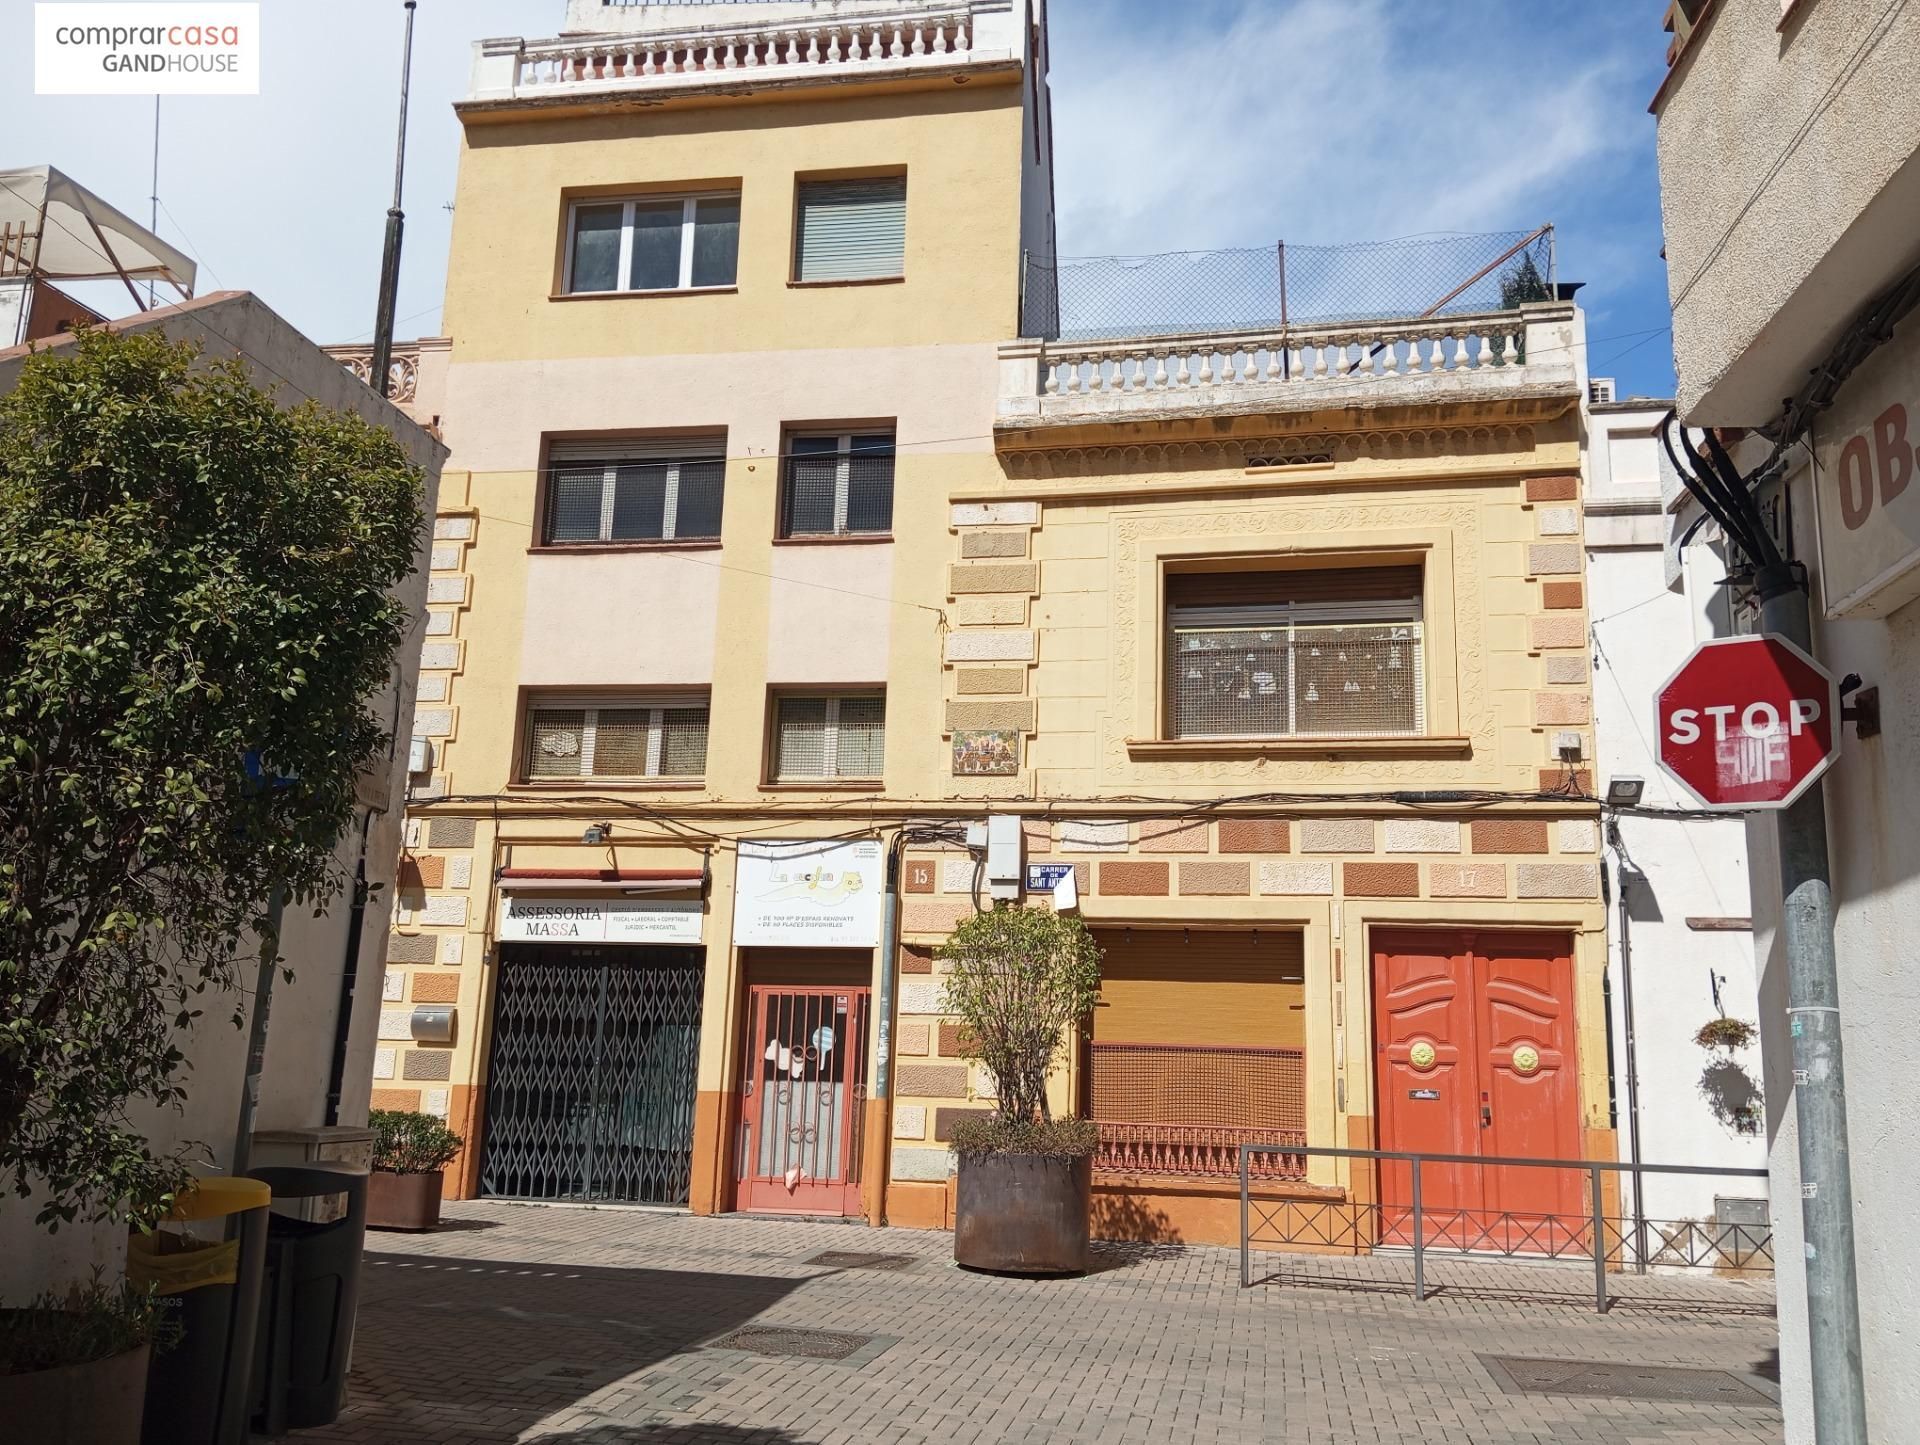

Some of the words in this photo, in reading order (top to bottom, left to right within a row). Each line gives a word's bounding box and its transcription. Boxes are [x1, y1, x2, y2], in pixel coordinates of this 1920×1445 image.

[1838, 402, 1920, 531] OB
[1668, 698, 1821, 745] STOP
[914, 869, 928, 884] 15
[1030, 878, 1046, 888] SANT
[1460, 870, 1476, 887] 17
[506, 906, 602, 920] ASSESSORIA
[526, 922, 579, 936] MASSA
